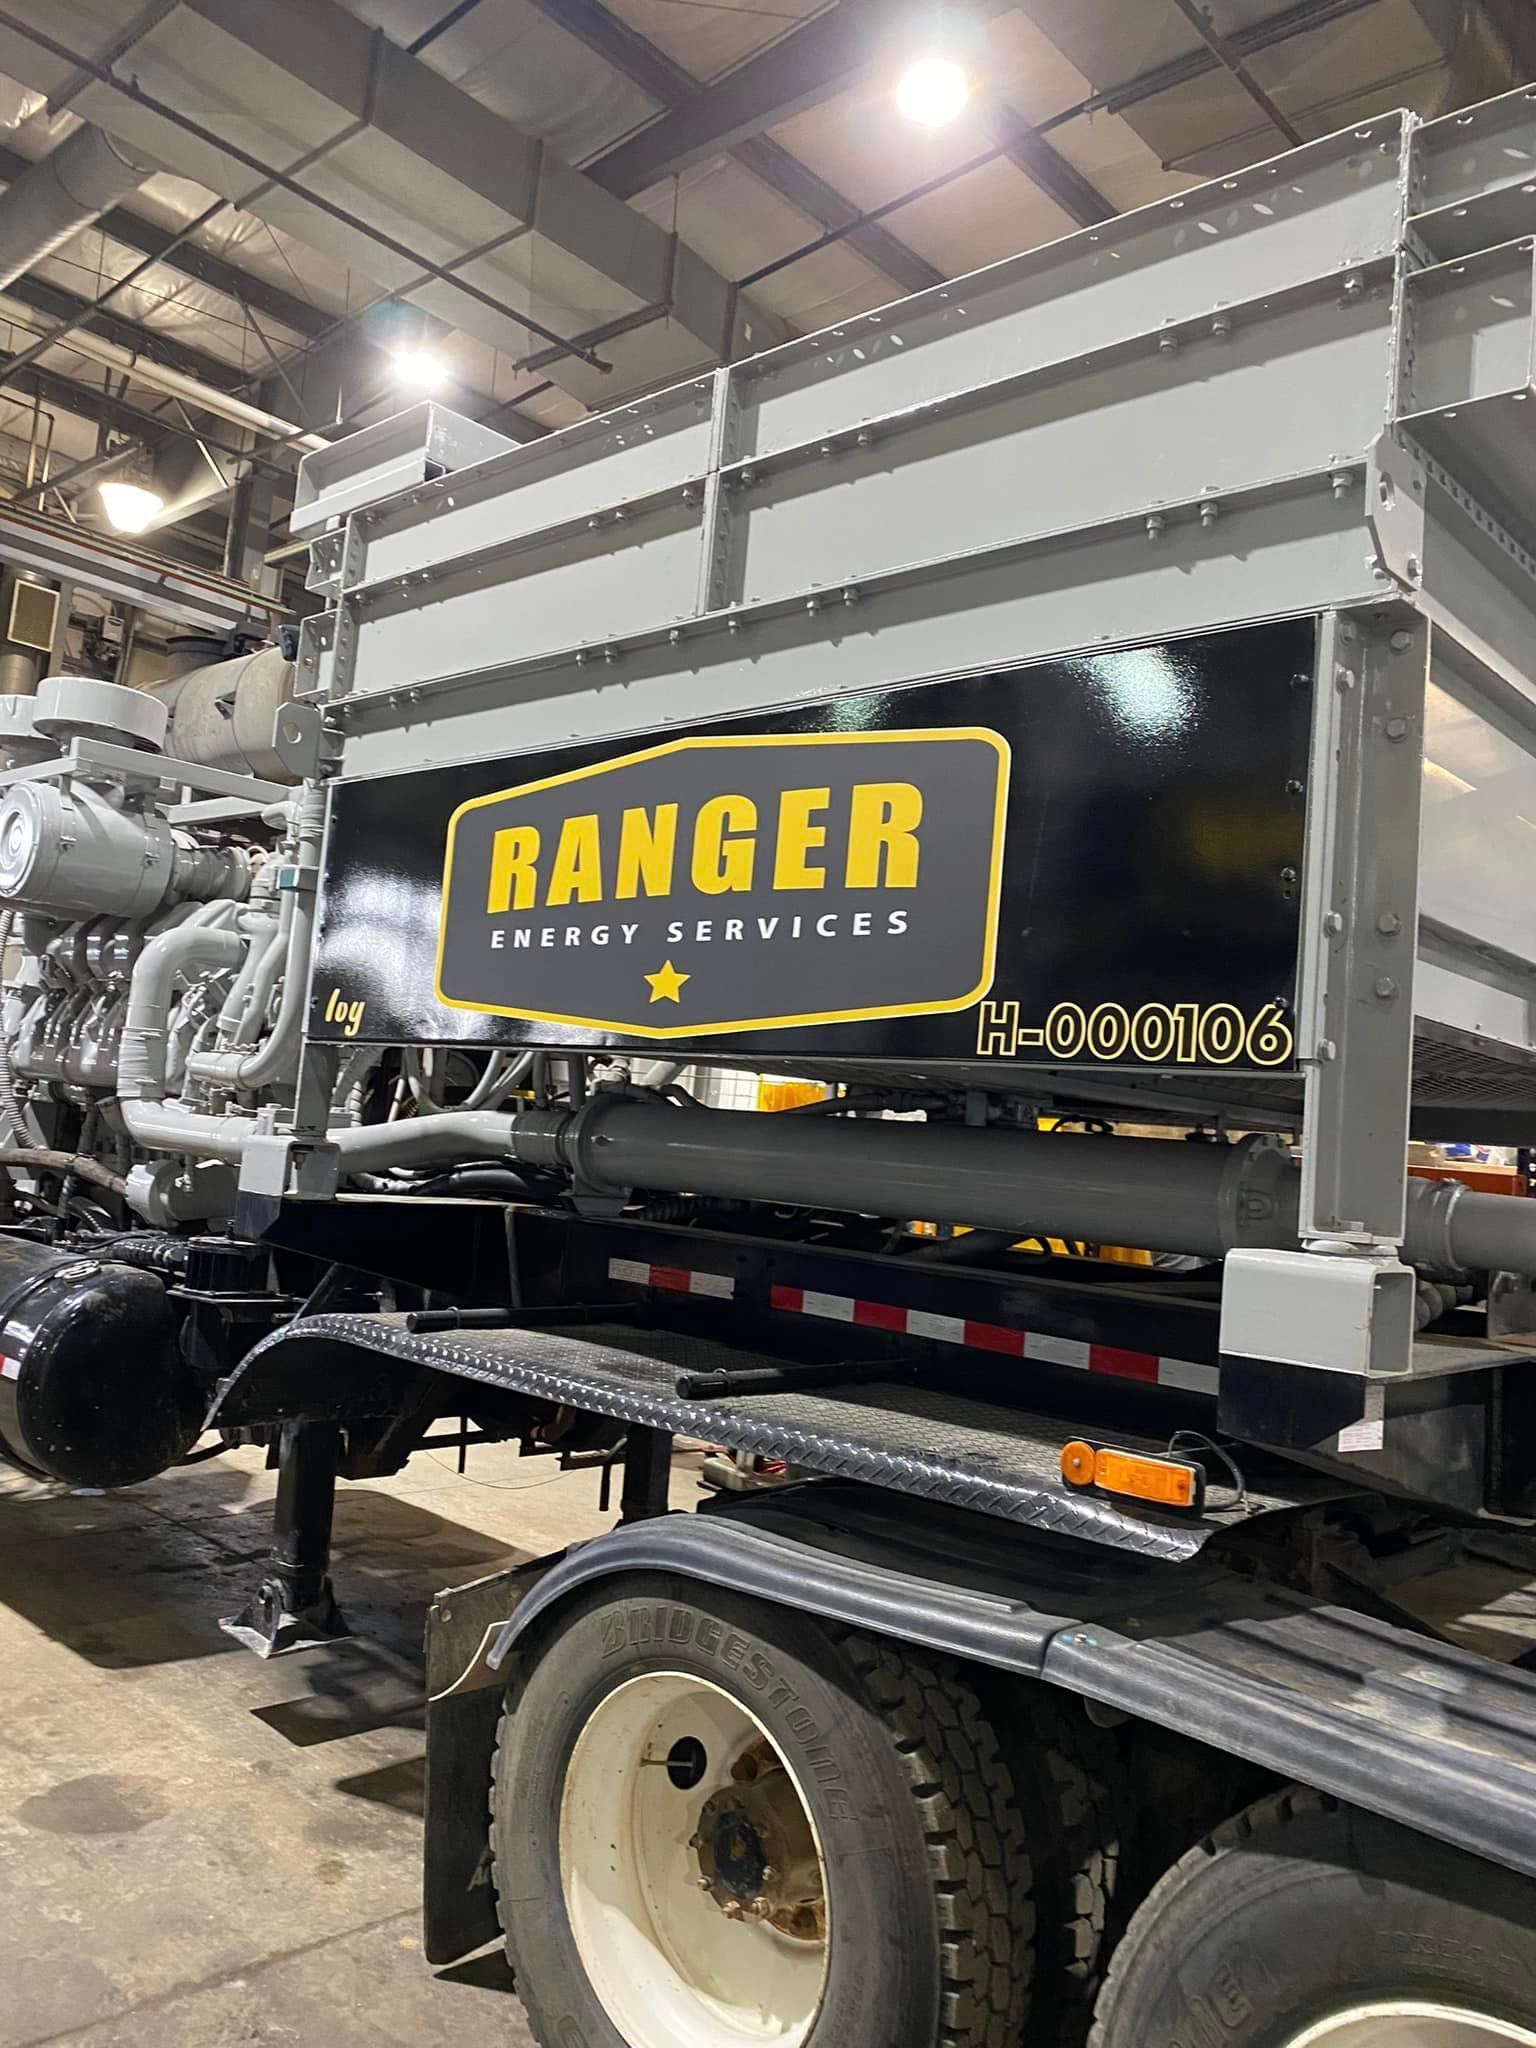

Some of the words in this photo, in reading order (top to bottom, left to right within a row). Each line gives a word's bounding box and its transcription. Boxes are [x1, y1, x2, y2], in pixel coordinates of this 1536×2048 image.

[487, 782, 922, 913] RANGER
[490, 923, 639, 949] ENERGY
[667, 910, 908, 943] SERVICES
[977, 1000, 1293, 1066] H-000106
[600, 1606, 858, 1820] BRIDGESTONE
